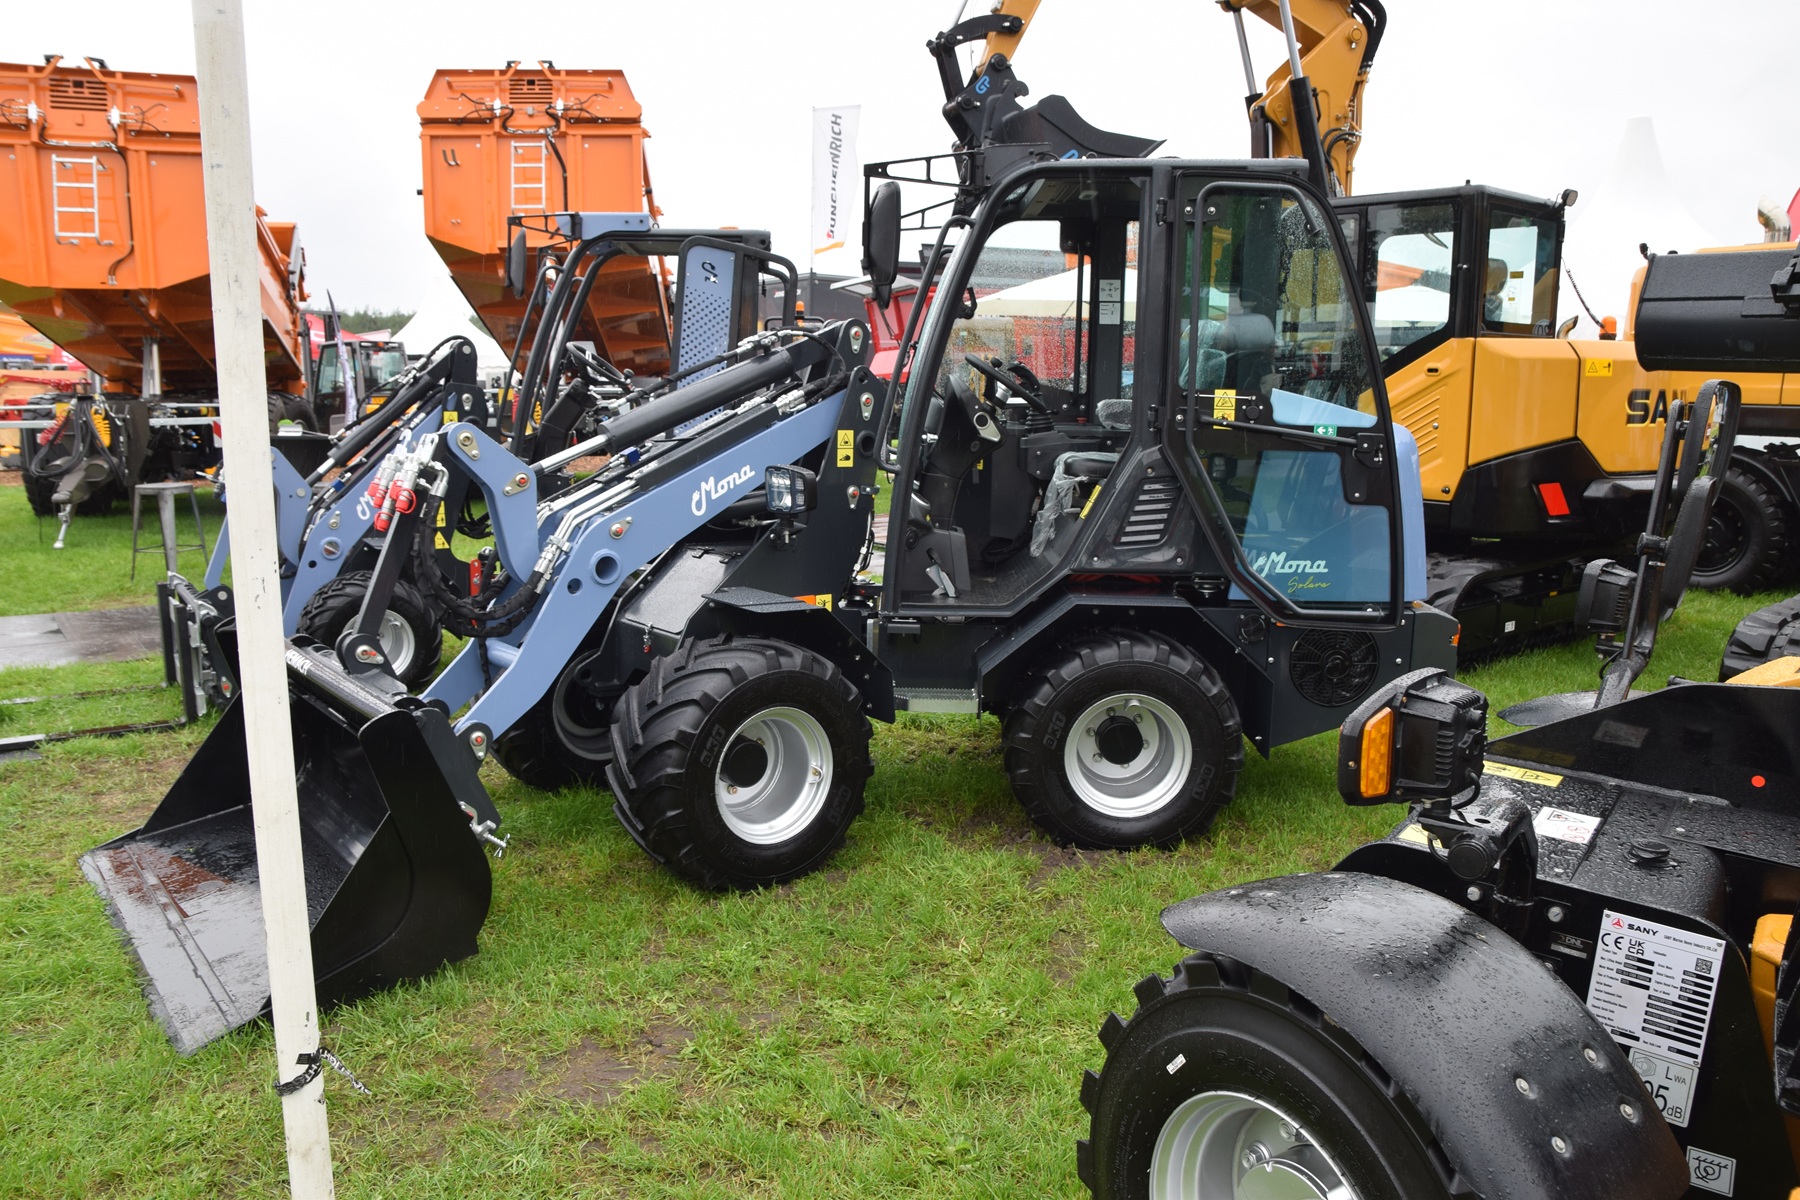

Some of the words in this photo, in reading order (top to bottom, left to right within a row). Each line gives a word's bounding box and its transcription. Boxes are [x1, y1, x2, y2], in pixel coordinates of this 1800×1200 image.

[691, 464, 755, 516] Mona
[1253, 551, 1328, 578] Mona
[1043, 711, 1067, 750] BKT
[1191, 764, 1215, 801] BKT
[1626, 923, 1658, 936] SANY
[1600, 931, 1624, 950] CE
[1628, 938, 1645, 948] UK
[1627, 945, 1644, 956] CA
[1666, 1105, 1683, 1119] dB
